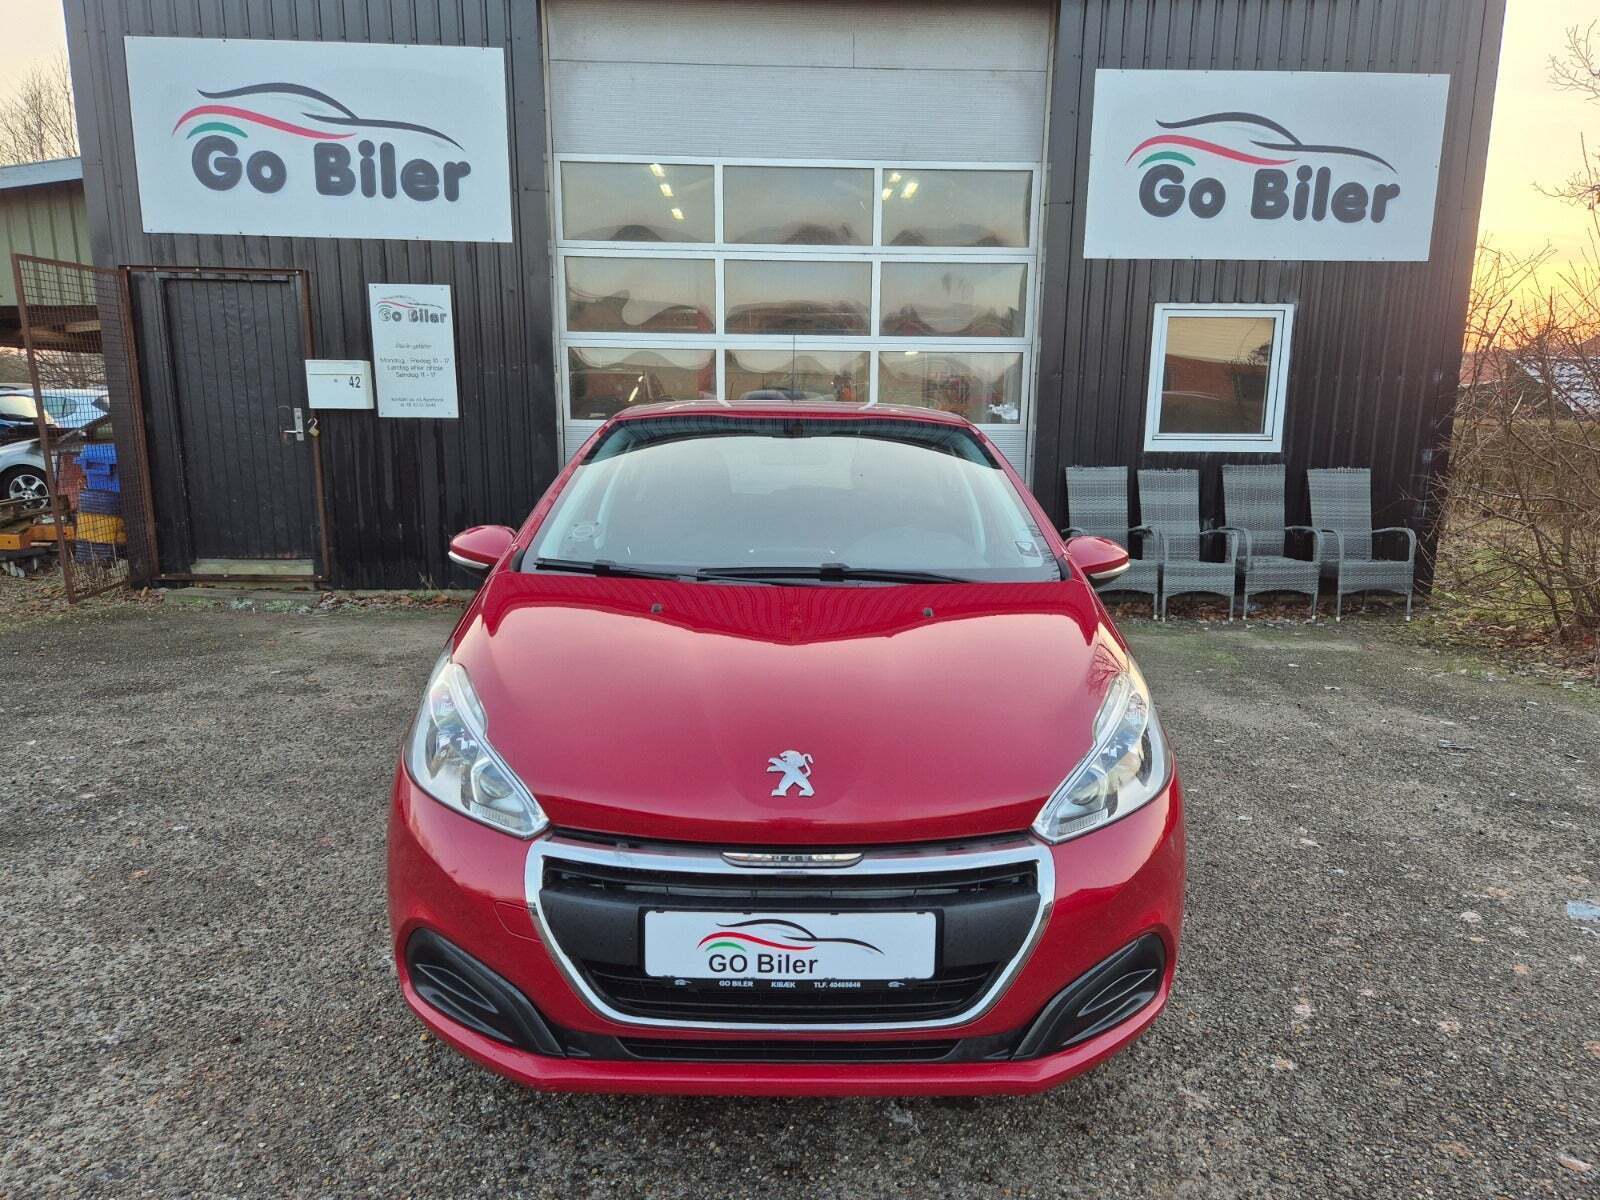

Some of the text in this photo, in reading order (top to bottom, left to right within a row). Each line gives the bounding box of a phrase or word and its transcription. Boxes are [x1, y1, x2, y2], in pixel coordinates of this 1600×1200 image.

[192, 134, 472, 203] Go Biler
[1138, 164, 1401, 223] Go Biler
[379, 307, 447, 324] Go Biler
[349, 376, 361, 389] 42
[708, 953, 818, 975] GO Biler
[732, 980, 754, 988] BILER
